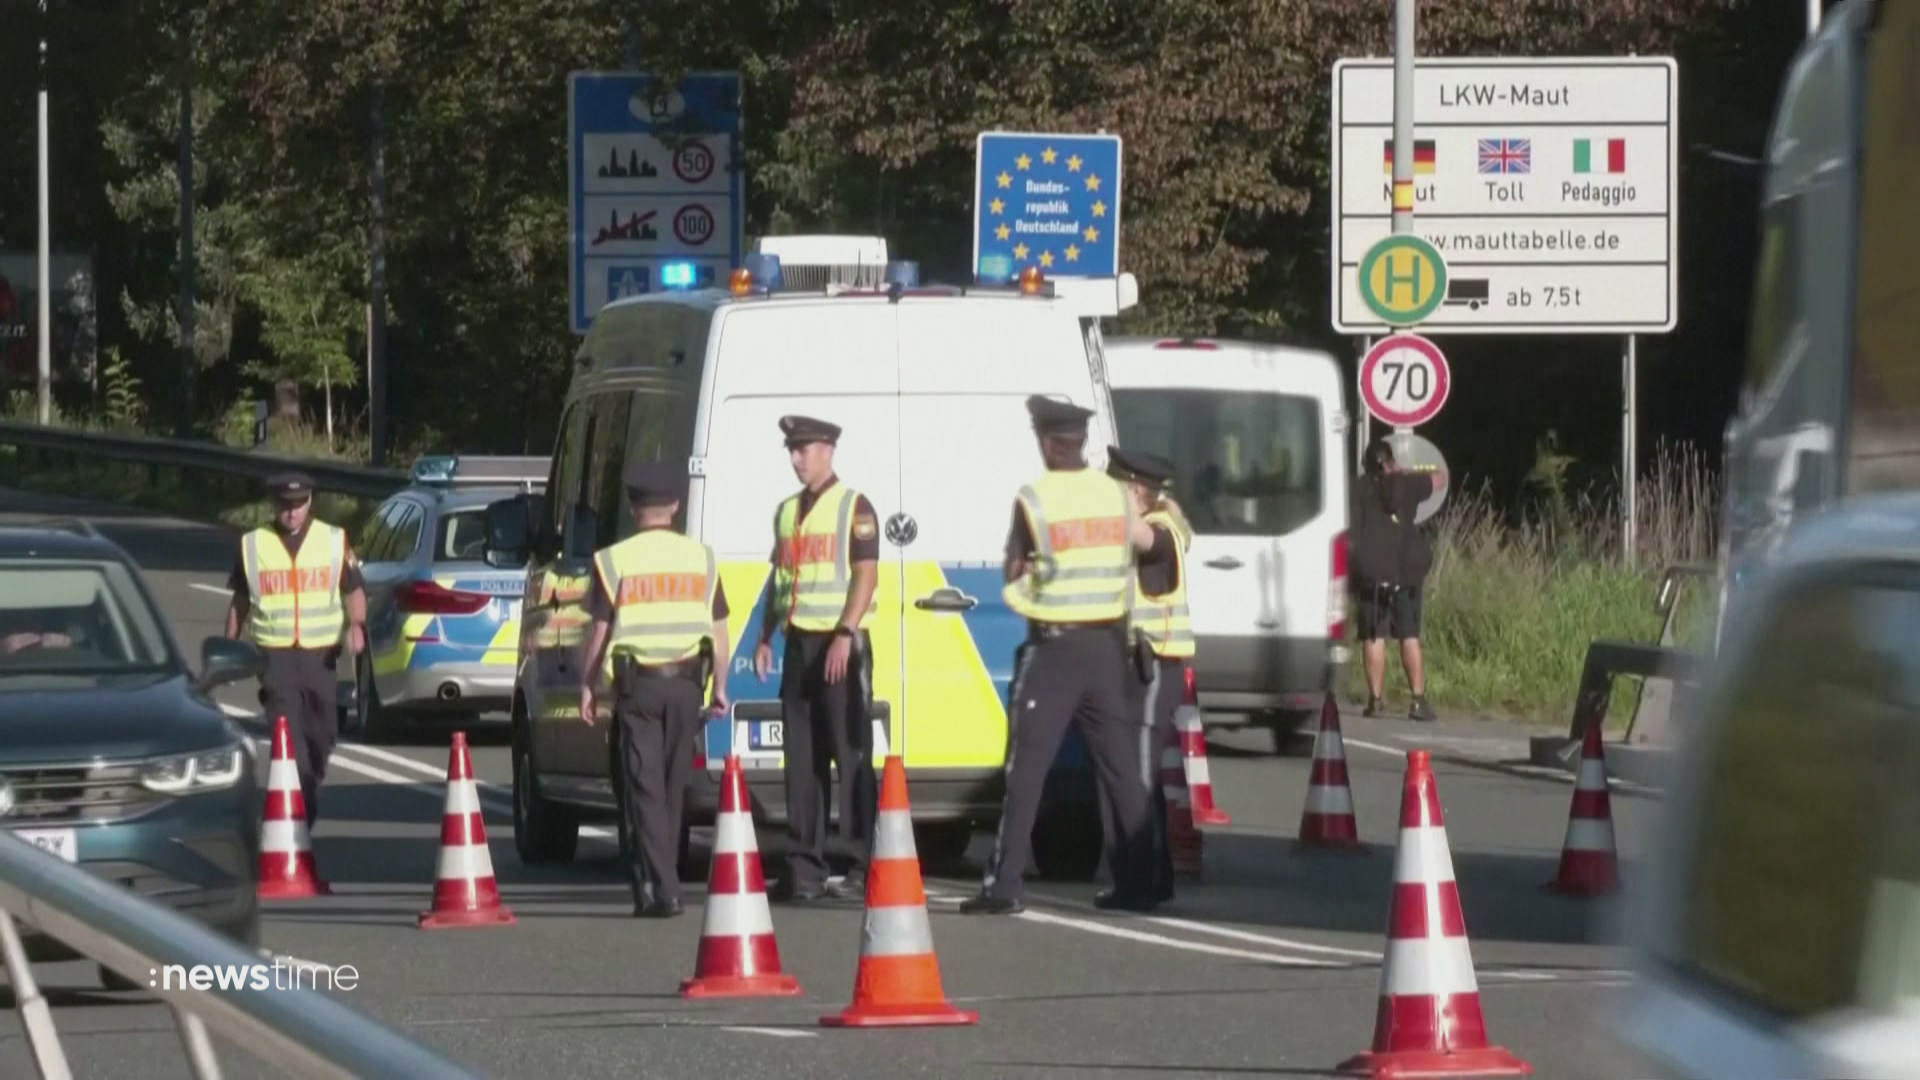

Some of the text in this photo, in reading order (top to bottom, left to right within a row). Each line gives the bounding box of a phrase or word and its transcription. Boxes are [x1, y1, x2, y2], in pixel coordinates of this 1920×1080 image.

[1440, 84, 1569, 106] LKW-Maut
[682, 153, 706, 173] 50
[1026, 179, 1071, 194] Bundes-
[1383, 182, 1436, 201] Mut
[1485, 182, 1524, 201] Toll
[1561, 181, 1636, 206] Pedaggio
[1026, 199, 1069, 216] republik
[682, 215, 707, 235] 100
[1015, 218, 1079, 234] Deutschland
[1384, 254, 1421, 305] H
[1506, 286, 1532, 306] ab
[1381, 362, 1429, 402] 70
